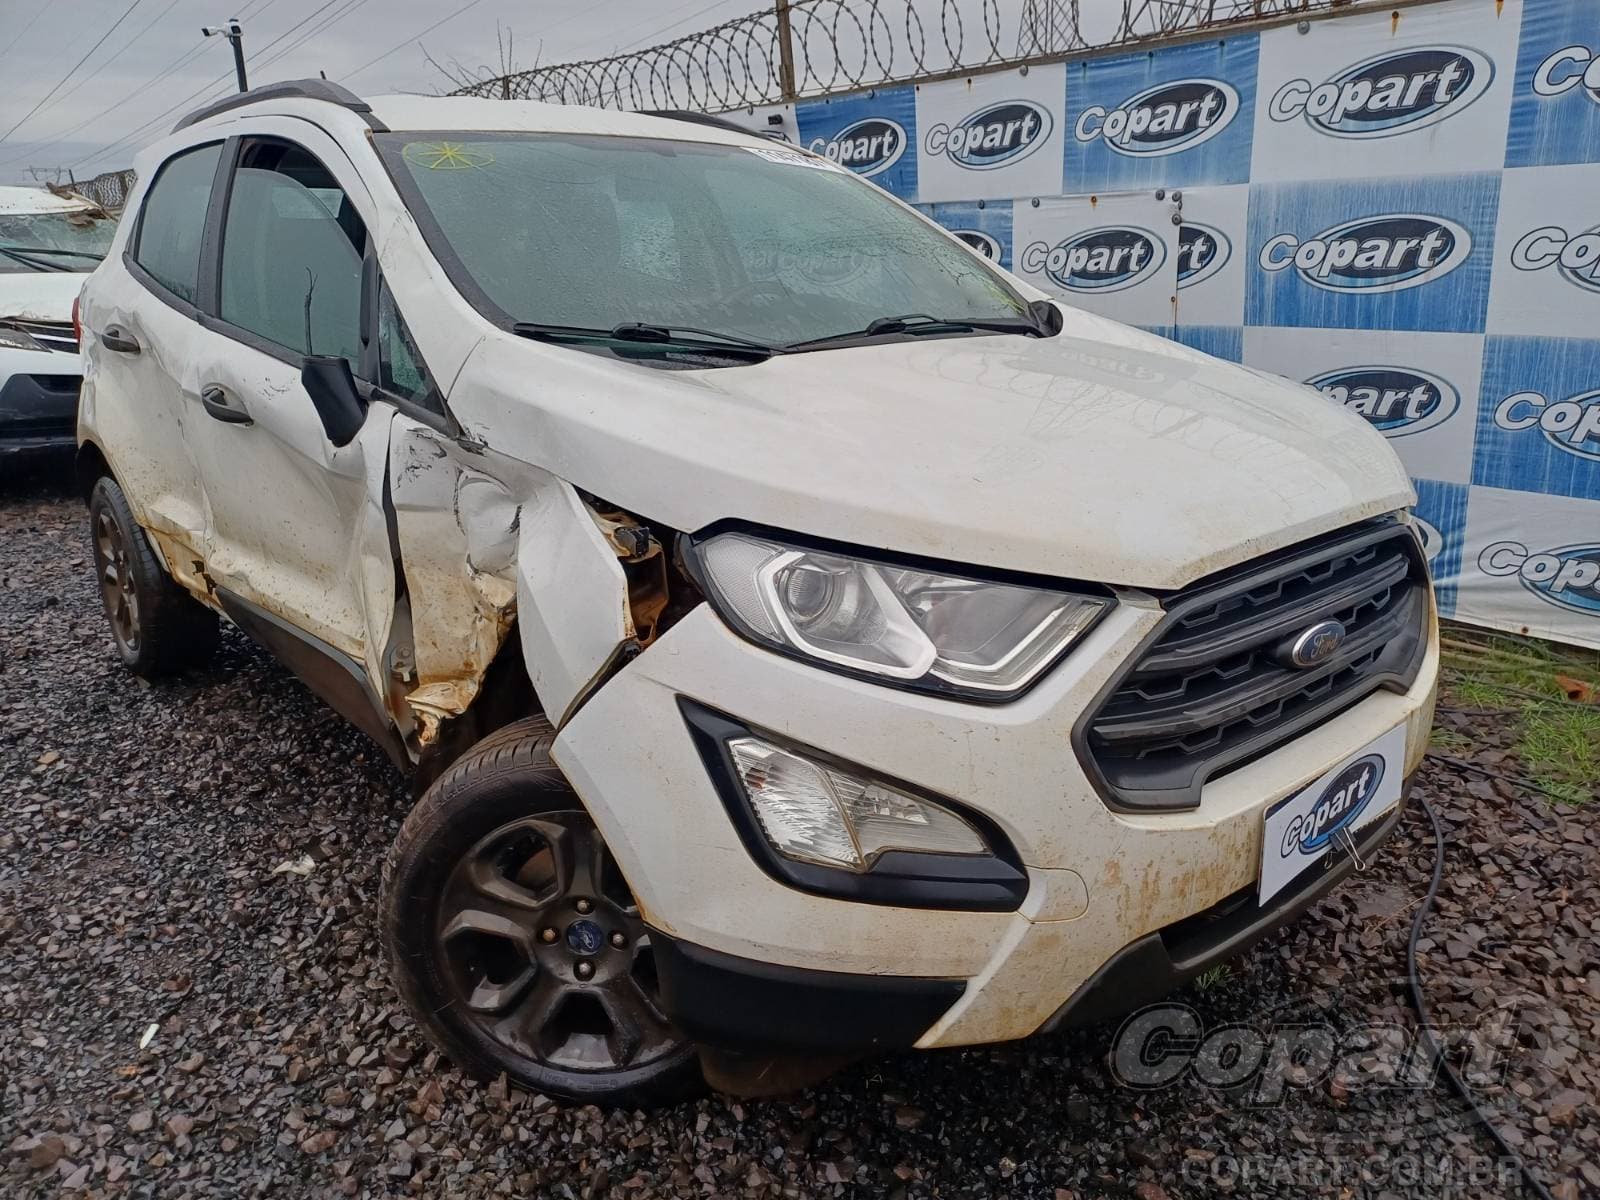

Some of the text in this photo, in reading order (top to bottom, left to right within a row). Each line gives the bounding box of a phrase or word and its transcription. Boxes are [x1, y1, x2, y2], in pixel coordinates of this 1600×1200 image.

[1075, 87, 1218, 145] Copart
[1269, 56, 1465, 125] Copart
[925, 107, 1040, 157] Copart
[1022, 236, 1148, 279] Copart
[1259, 226, 1447, 278] Copart
[1478, 541, 1600, 593] Cop
[1281, 765, 1371, 859] Copart
